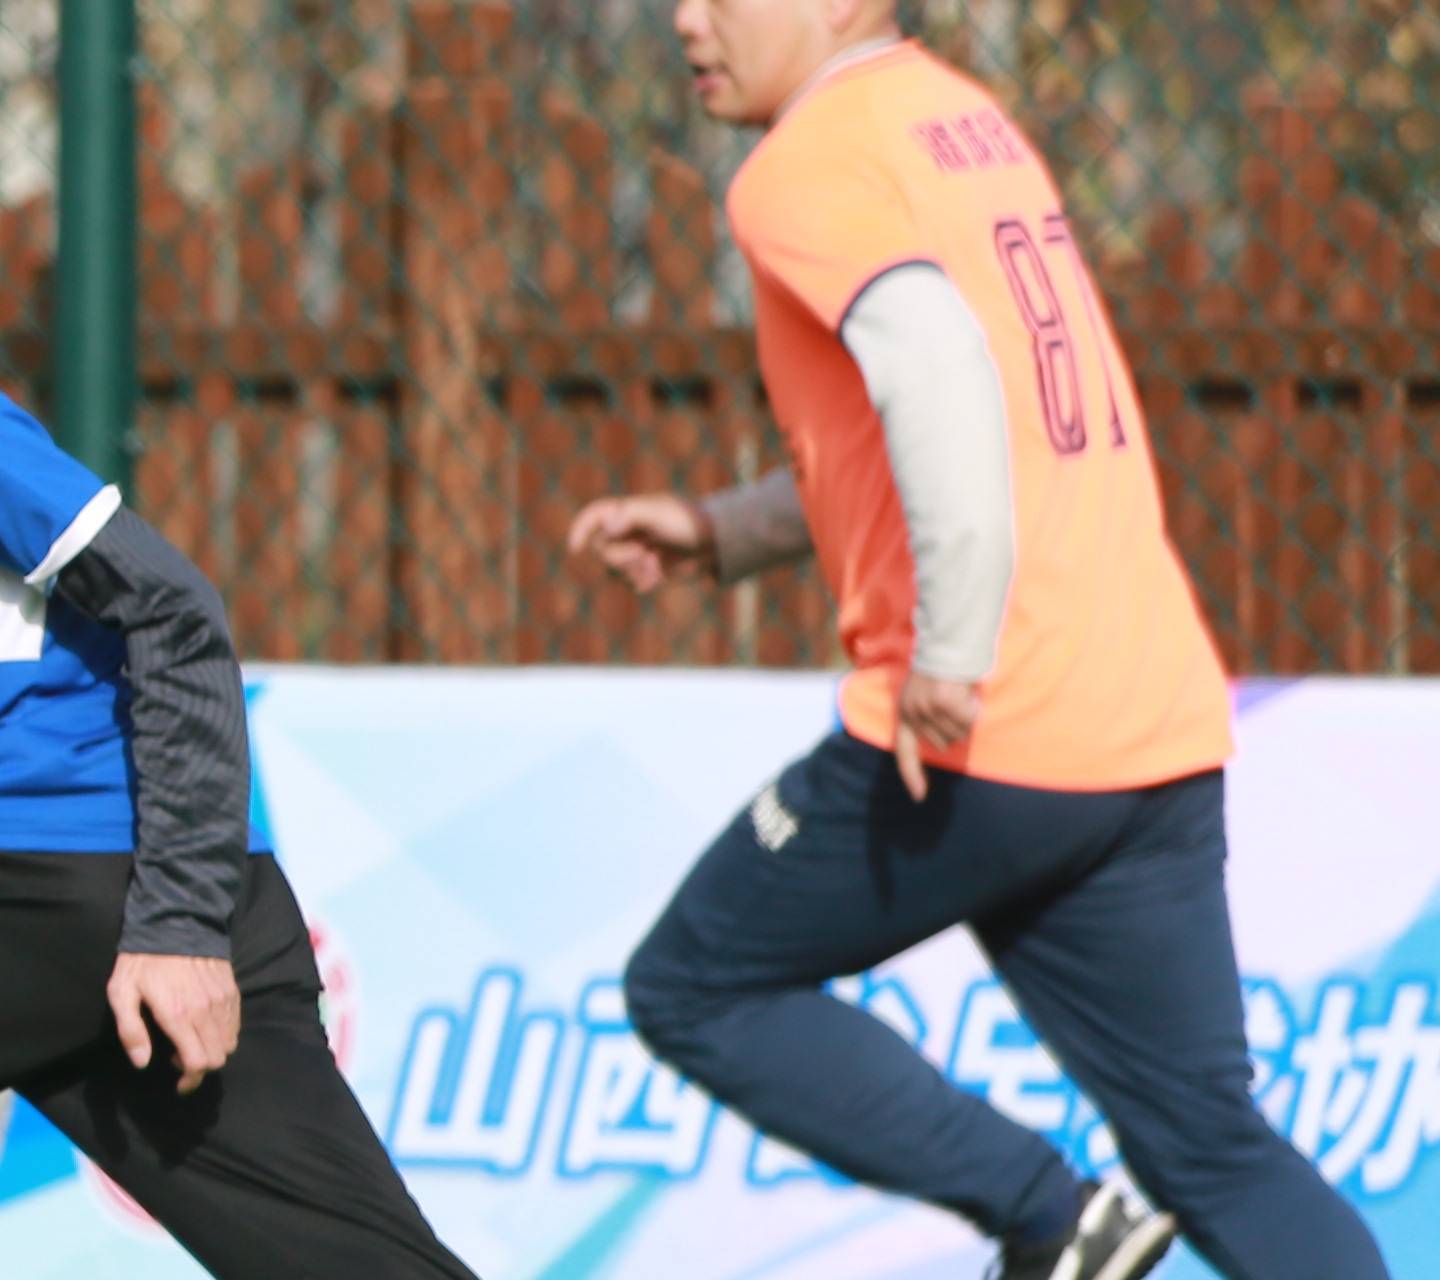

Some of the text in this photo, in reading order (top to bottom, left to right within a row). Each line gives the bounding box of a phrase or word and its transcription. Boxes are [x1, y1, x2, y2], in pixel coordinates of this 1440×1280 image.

[994, 215, 1127, 453] 87
[388, 966, 1440, 1192] 山西协
